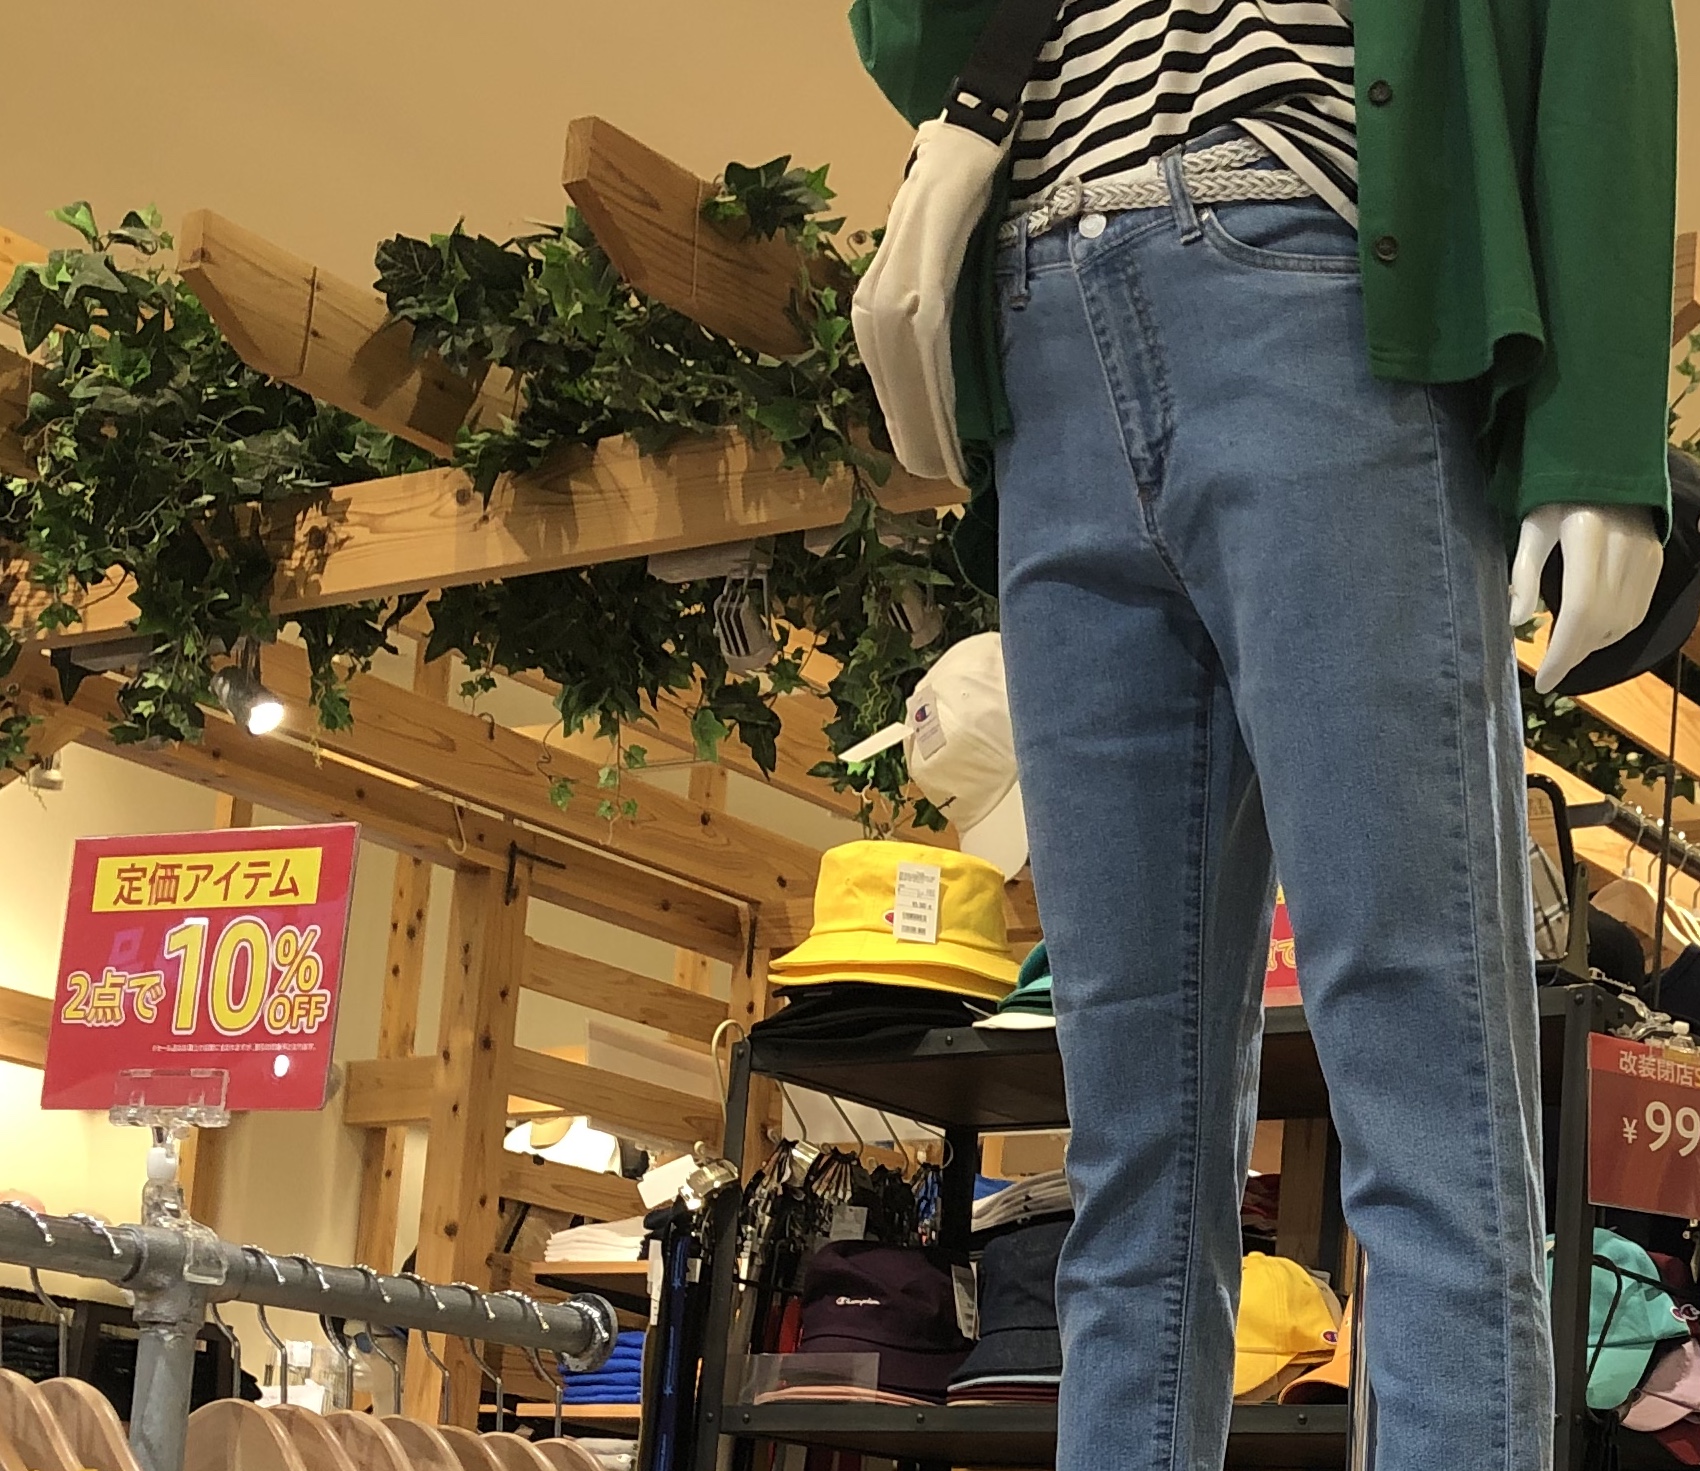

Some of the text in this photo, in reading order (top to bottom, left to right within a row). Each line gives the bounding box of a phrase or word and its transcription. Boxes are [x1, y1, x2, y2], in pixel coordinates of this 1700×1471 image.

[113, 858, 300, 906] 定価アイテム
